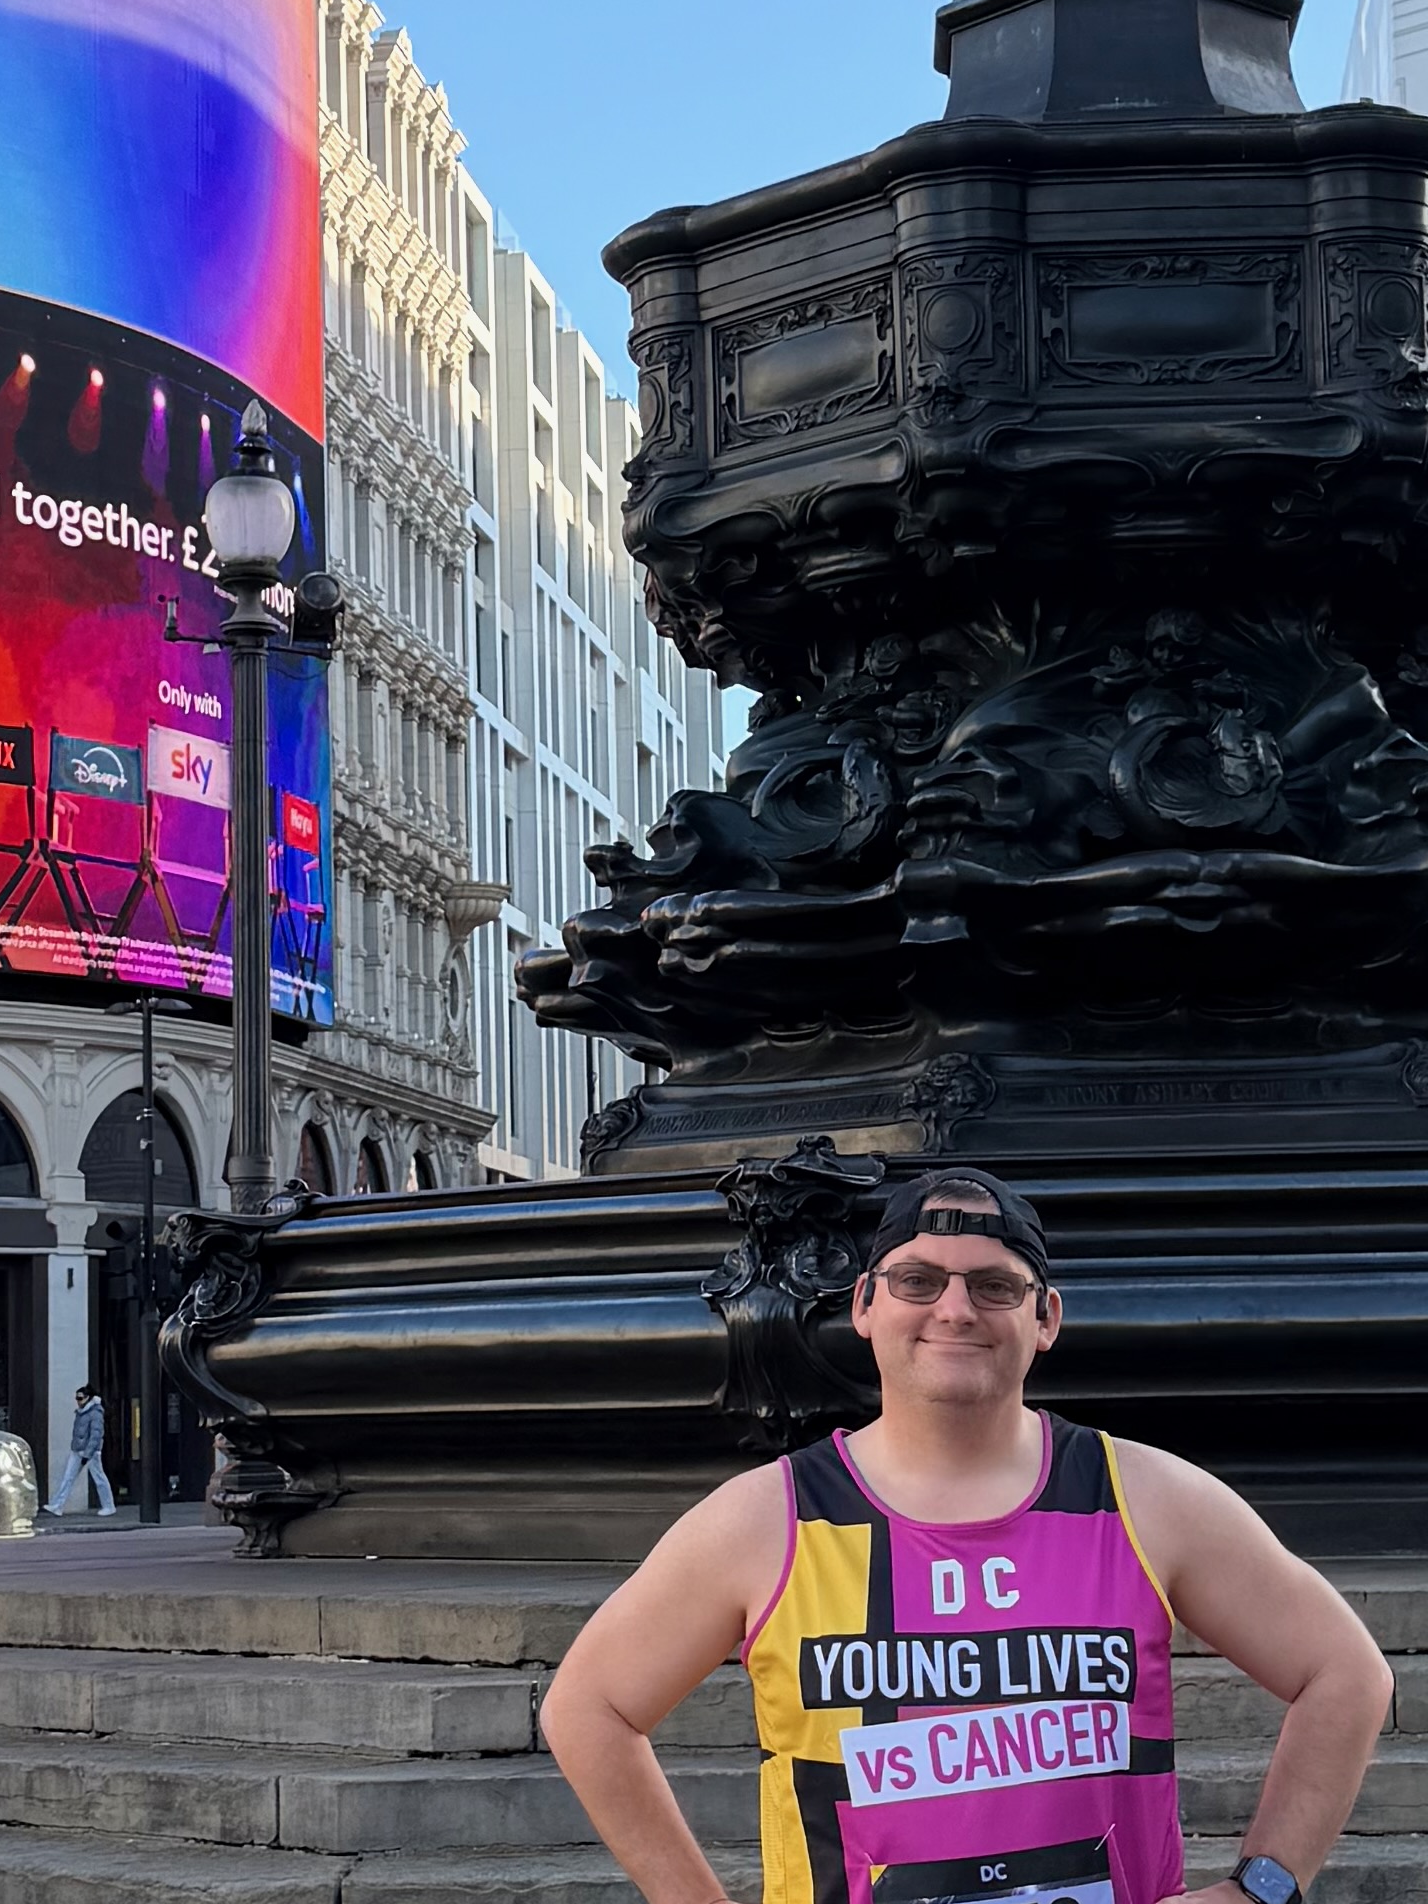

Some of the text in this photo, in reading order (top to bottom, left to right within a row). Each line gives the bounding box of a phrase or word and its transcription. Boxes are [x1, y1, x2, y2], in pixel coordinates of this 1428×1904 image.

[11, 481, 176, 563] together.
[158, 680, 223, 720] Only with
[171, 743, 213, 795] sky
[813, 1633, 1131, 1701] YOUNG LIVES
[927, 1702, 1120, 1785] CANCER
[979, 1862, 1009, 1884] DC
